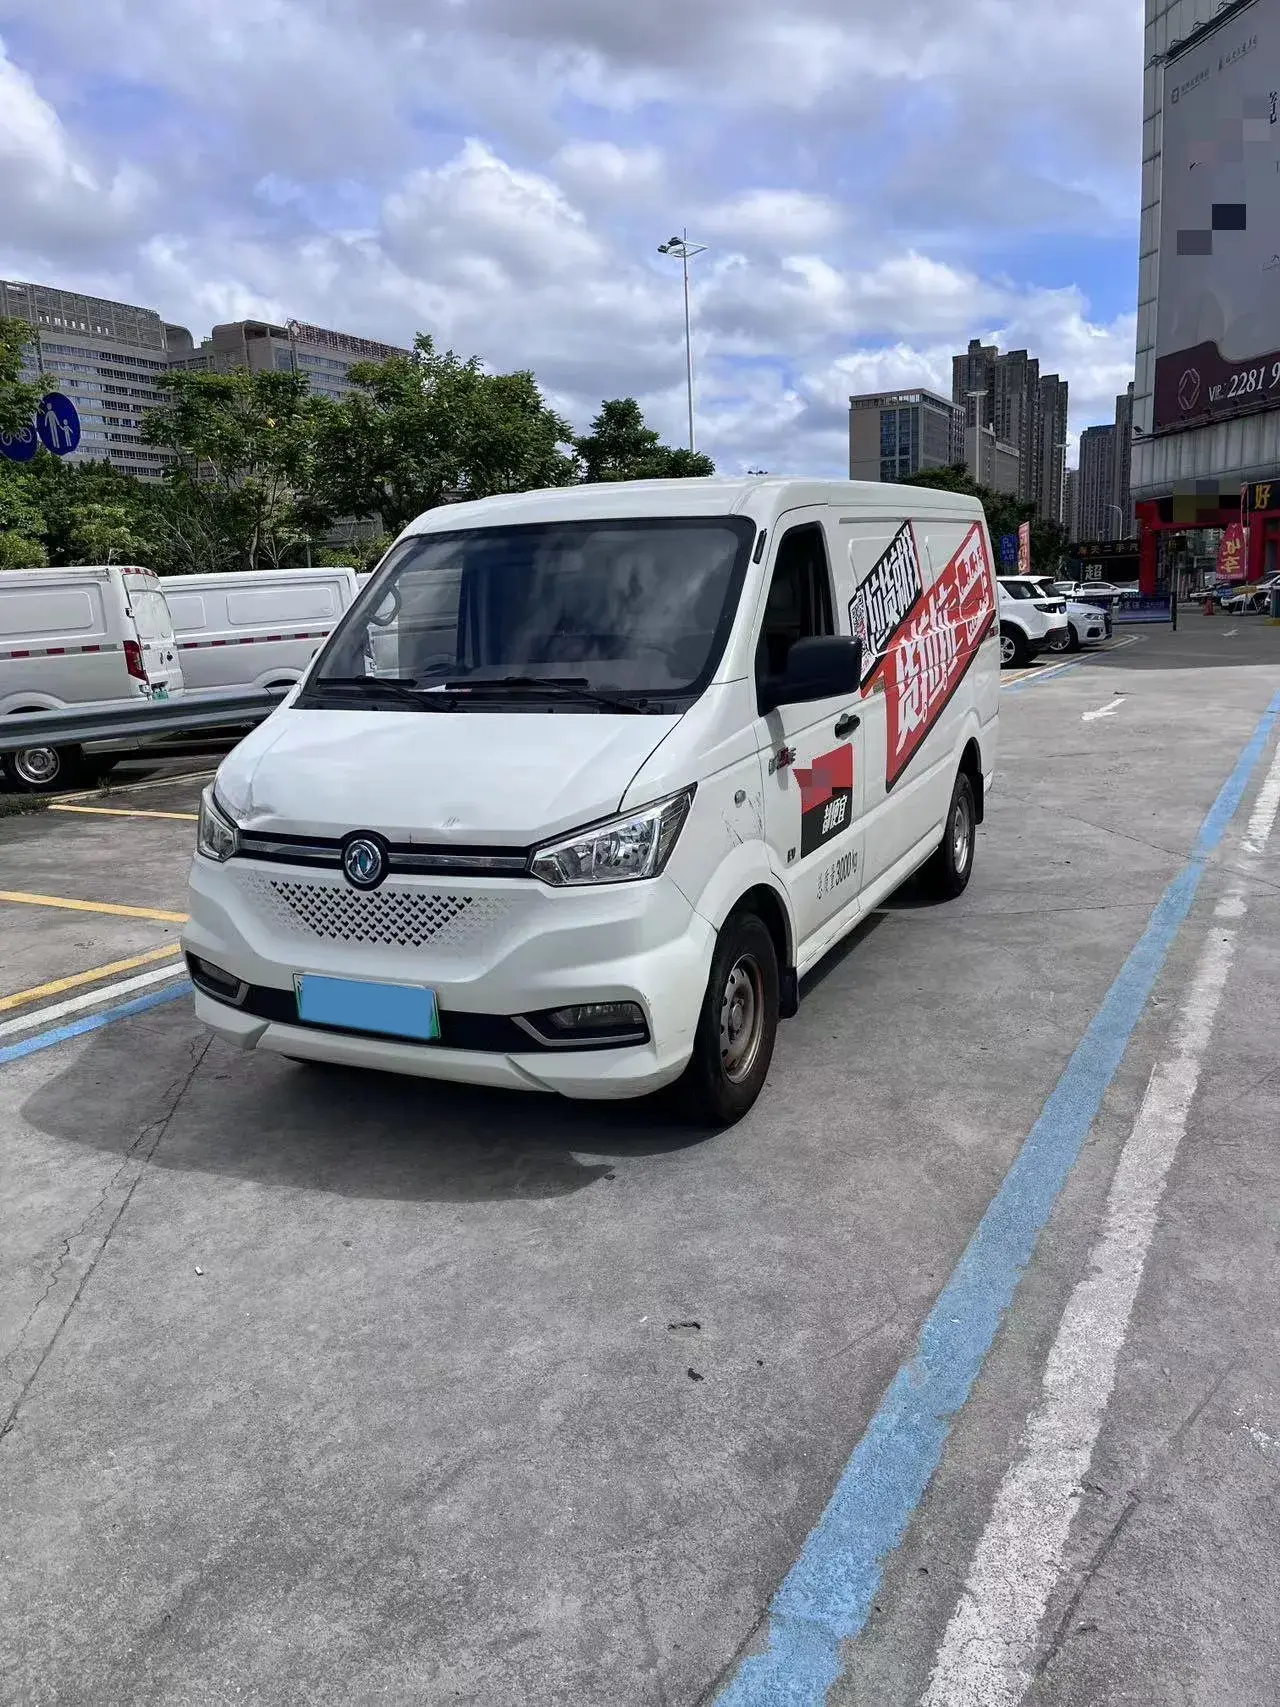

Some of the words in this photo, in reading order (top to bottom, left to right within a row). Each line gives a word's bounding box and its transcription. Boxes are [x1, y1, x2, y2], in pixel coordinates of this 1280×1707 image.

[1227, 366, 1266, 398] 2281
[865, 524, 922, 658] 拉货就找
